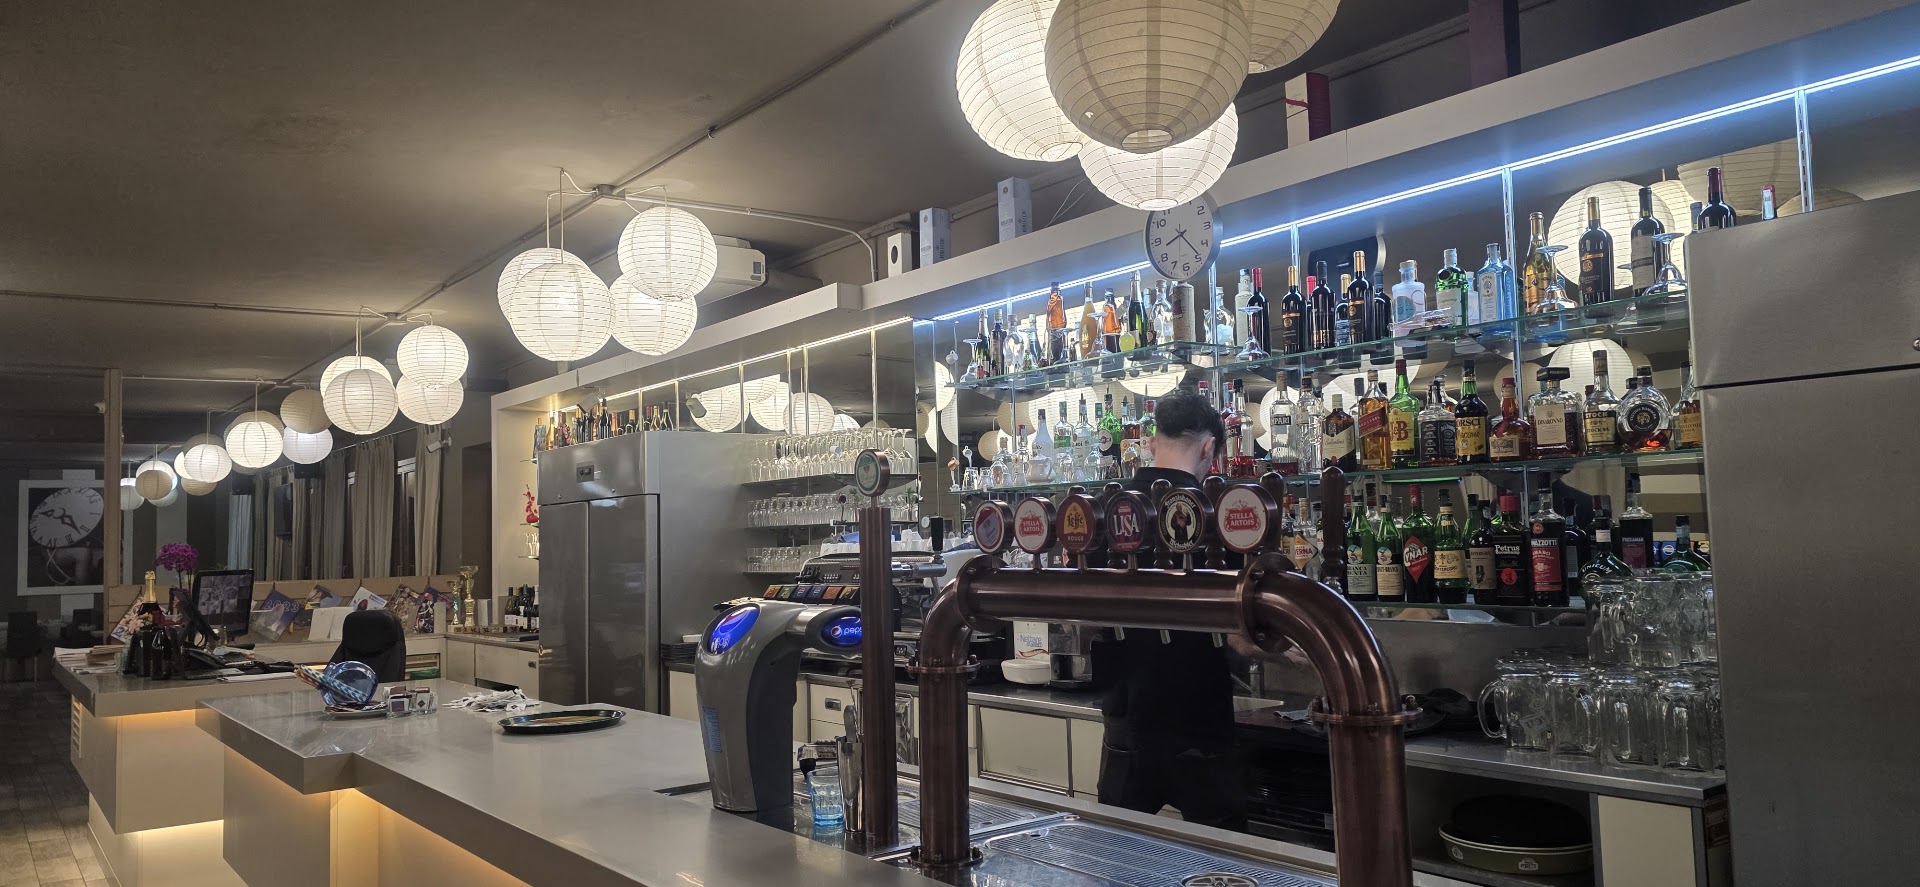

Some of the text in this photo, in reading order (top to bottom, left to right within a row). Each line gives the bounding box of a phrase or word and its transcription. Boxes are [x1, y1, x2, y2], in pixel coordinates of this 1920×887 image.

[1197, 205, 1205, 215] 2
[1156, 218, 1167, 229] 10
[1203, 221, 1211, 230] 3
[1154, 237, 1162, 247] 9
[1201, 239, 1209, 247] 4
[1160, 252, 1168, 262] 8
[1194, 253, 1202, 262] 5
[1171, 261, 1178, 270] 7
[1182, 262, 1190, 272] 6
[1229, 512, 1254, 520] STELLA
[1113, 512, 1140, 537] LISA
[1230, 519, 1255, 527] ARTOIS
[1494, 544, 1520, 552] Petrus
[1403, 546, 1429, 567] CYNAR
[1581, 562, 1612, 574] UNICUM
[264, 599, 300, 613] 2023
